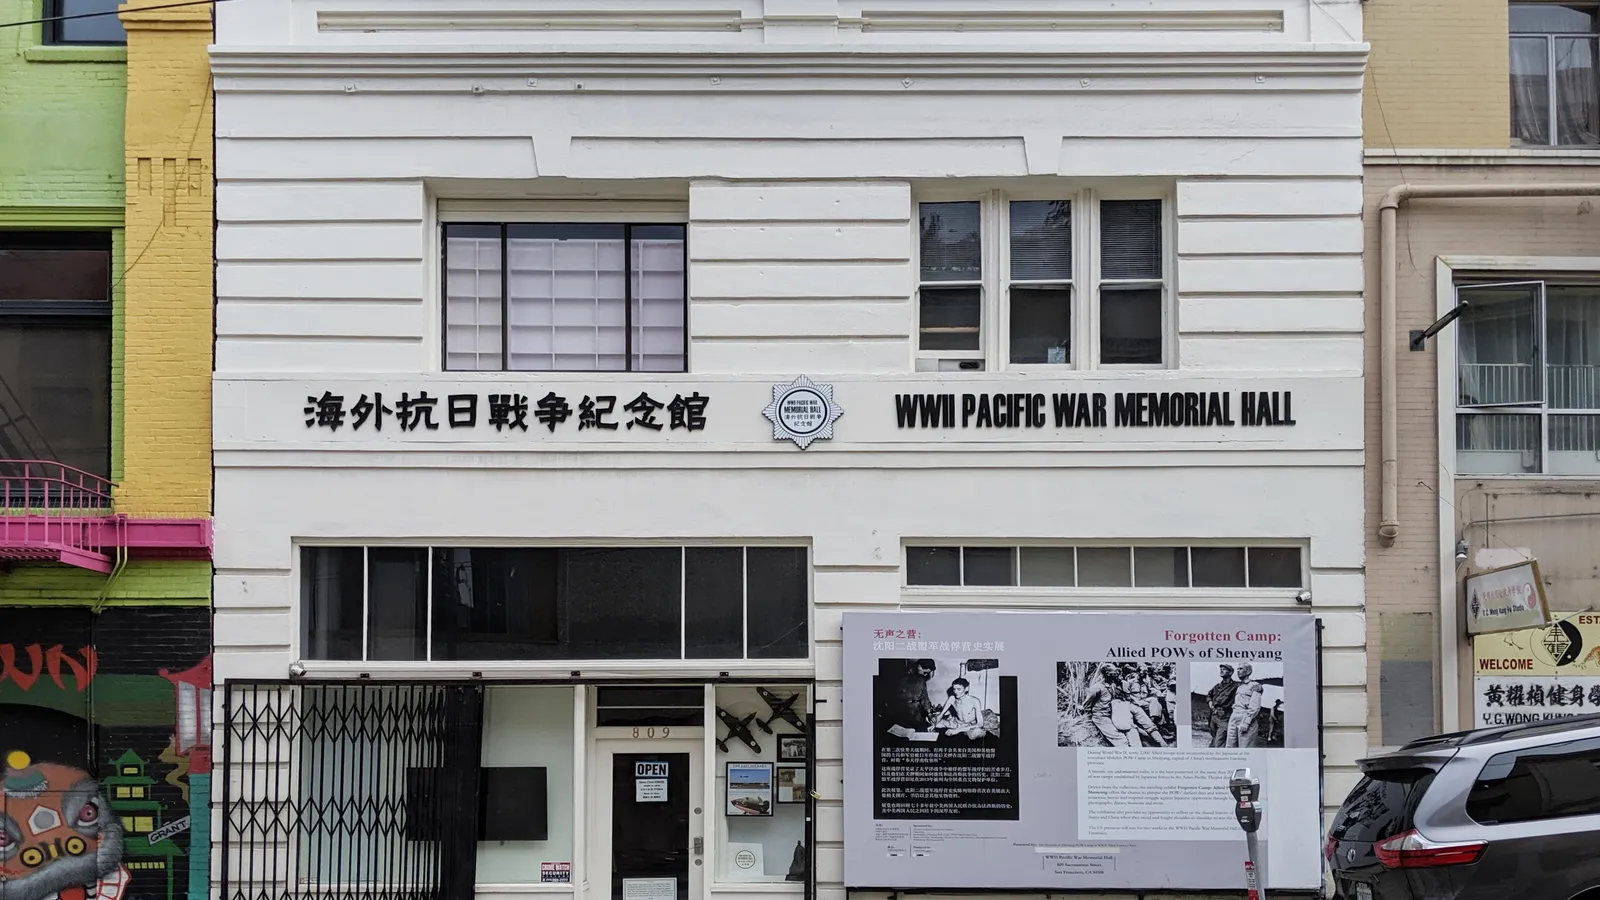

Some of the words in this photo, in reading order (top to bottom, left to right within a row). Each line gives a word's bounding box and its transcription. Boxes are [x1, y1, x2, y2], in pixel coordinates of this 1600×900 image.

[895, 394, 955, 428] WWII
[962, 393, 1046, 428] PACIFIC
[1053, 393, 1107, 427] WAR
[1115, 392, 1235, 427] MEMORIAL
[1241, 391, 1296, 426] HALL
[1512, 604, 1524, 612] Studio
[1164, 630, 1230, 644] Forgotten
[1235, 630, 1282, 644] Camp:
[1106, 646, 1146, 659] Allied
[1151, 646, 1195, 659] POWs
[1198, 647, 1212, 659] of
[1216, 647, 1283, 661] Shenyang
[1480, 659, 1533, 670] WELCOME
[632, 727, 671, 739] 809
[637, 763, 667, 776] OPEN
[150, 820, 186, 842] GRANT
